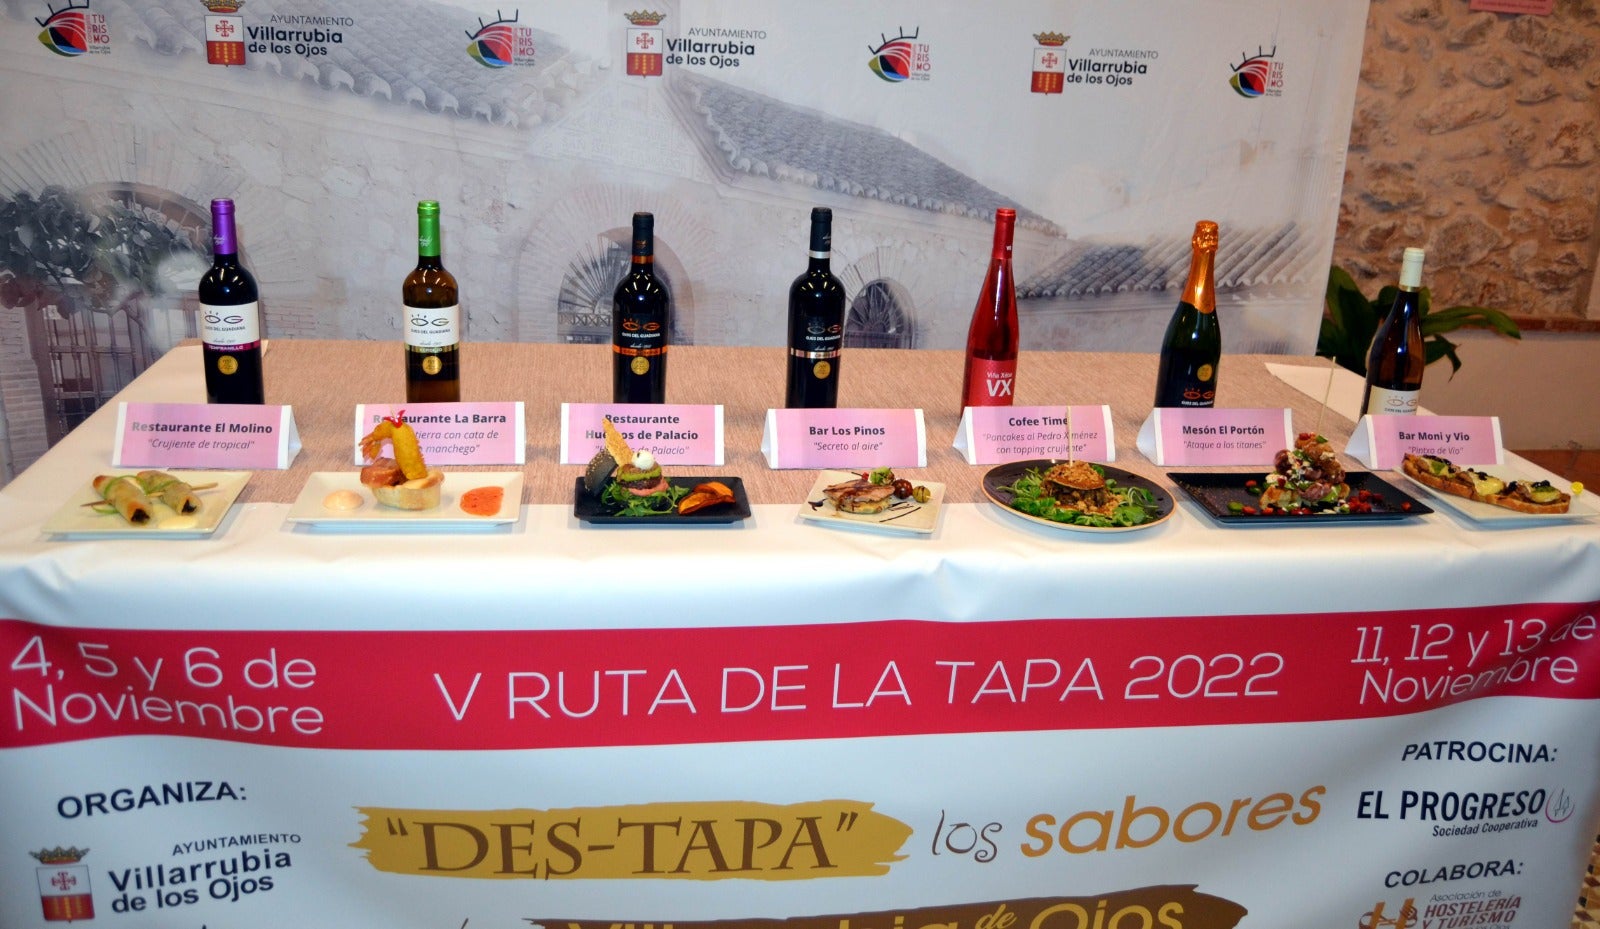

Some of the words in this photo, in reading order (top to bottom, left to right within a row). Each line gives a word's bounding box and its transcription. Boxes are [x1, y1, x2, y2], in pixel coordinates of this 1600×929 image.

[270, 14, 354, 27] AYUNTAMIENTO
[247, 26, 343, 43] Villarrubia
[688, 27, 767, 40] AYUNTAMIENTO
[248, 42, 267, 53] de
[271, 42, 291, 54] los
[295, 43, 328, 58] Ojos
[666, 38, 755, 56] Villarrubia
[1089, 48, 1159, 60] AYUNTAMIENTO
[666, 54, 683, 65] de
[687, 54, 706, 66] los
[709, 55, 740, 69] Ojos
[1069, 59, 1147, 75] Villarrubia
[1067, 73, 1082, 83] de
[1085, 73, 1103, 84] los
[1106, 74, 1133, 87] Ojos
[987, 379, 1012, 397] VX
[455, 414, 469, 423] La
[472, 414, 507, 423] Barra
[605, 414, 680, 424] Restaurante
[1009, 417, 1039, 426] Cofee
[132, 421, 211, 433] Restaurante
[215, 423, 226, 433] El
[229, 423, 273, 433] Molino
[464, 431, 485, 439] cata
[487, 430, 499, 439] de
[809, 426, 828, 435] Bar
[832, 426, 851, 435] Los
[854, 426, 885, 435] Pinos
[1182, 425, 1216, 434] Mesón
[1219, 425, 1228, 434] El
[1230, 425, 1265, 434] Portón
[637, 430, 652, 439] de
[655, 430, 698, 440] Palacio
[982, 433, 1025, 442] "Pancakes
[1027, 433, 1035, 441] al
[1037, 432, 1062, 441] Pedro
[1064, 431, 1098, 440] Xménez
[1399, 432, 1415, 440] Bar
[1418, 432, 1443, 440] Moni
[1445, 434, 1451, 443] y
[1453, 432, 1470, 440] Vio
[148, 438, 196, 450] "Crujiente
[198, 439, 210, 449] de
[212, 440, 255, 450] tropical"
[426, 444, 480, 456] manchego"
[651, 446, 690, 455] Palacio"
[814, 442, 849, 451] "Secreto
[851, 442, 860, 451] al
[862, 442, 883, 451] aire"
[996, 446, 1011, 454] con
[1013, 445, 1045, 455] topping
[1183, 441, 1214, 450] "Ataque
[1223, 441, 1235, 449] los
[1237, 441, 1267, 449] titanes"
[1408, 446, 1435, 454] "Pintxo
[1448, 447, 1464, 455] Vio"
[1351, 626, 1389, 666] 11,
[1404, 623, 1454, 661] 12
[1467, 631, 1489, 668] y
[1499, 619, 1547, 656] 13
[1549, 615, 1597, 643] de
[11, 636, 65, 681] 4,
[78, 642, 118, 677] 5
[134, 656, 163, 691] y
[184, 647, 223, 688] 6
[244, 648, 317, 688] de
[433, 672, 482, 722] V
[508, 668, 697, 719] RUTA
[721, 665, 809, 713] DE
[832, 660, 912, 709] LA
[935, 657, 1104, 704] TAPA
[1124, 652, 1285, 700] 2022
[1359, 655, 1578, 705] Noviembre
[13, 684, 324, 734] Noviembre
[1401, 741, 1558, 763] PATROCINA:
[57, 781, 247, 819] ORGANIZA:
[1357, 790, 1389, 819] EL
[1400, 788, 1546, 821] PROGRESO
[931, 809, 1003, 863] los
[1020, 785, 1327, 858] sabores
[1432, 824, 1480, 837] Sociedad
[1482, 819, 1539, 834] Cooperativa
[172, 833, 302, 856] AYUNTAMIENTO
[108, 848, 292, 892] Villarrubia
[1385, 859, 1524, 888] COLABORA:
[111, 893, 147, 914] de
[157, 888, 200, 909] los
[209, 875, 274, 902] Ojos
[1430, 891, 1485, 902] Asociación
[1488, 890, 1502, 898] de
[1424, 894, 1522, 918] HOSTELERÍA
[975, 904, 1017, 929] de
[1423, 920, 1432, 929] Y
[1438, 910, 1516, 929] TURISMO
